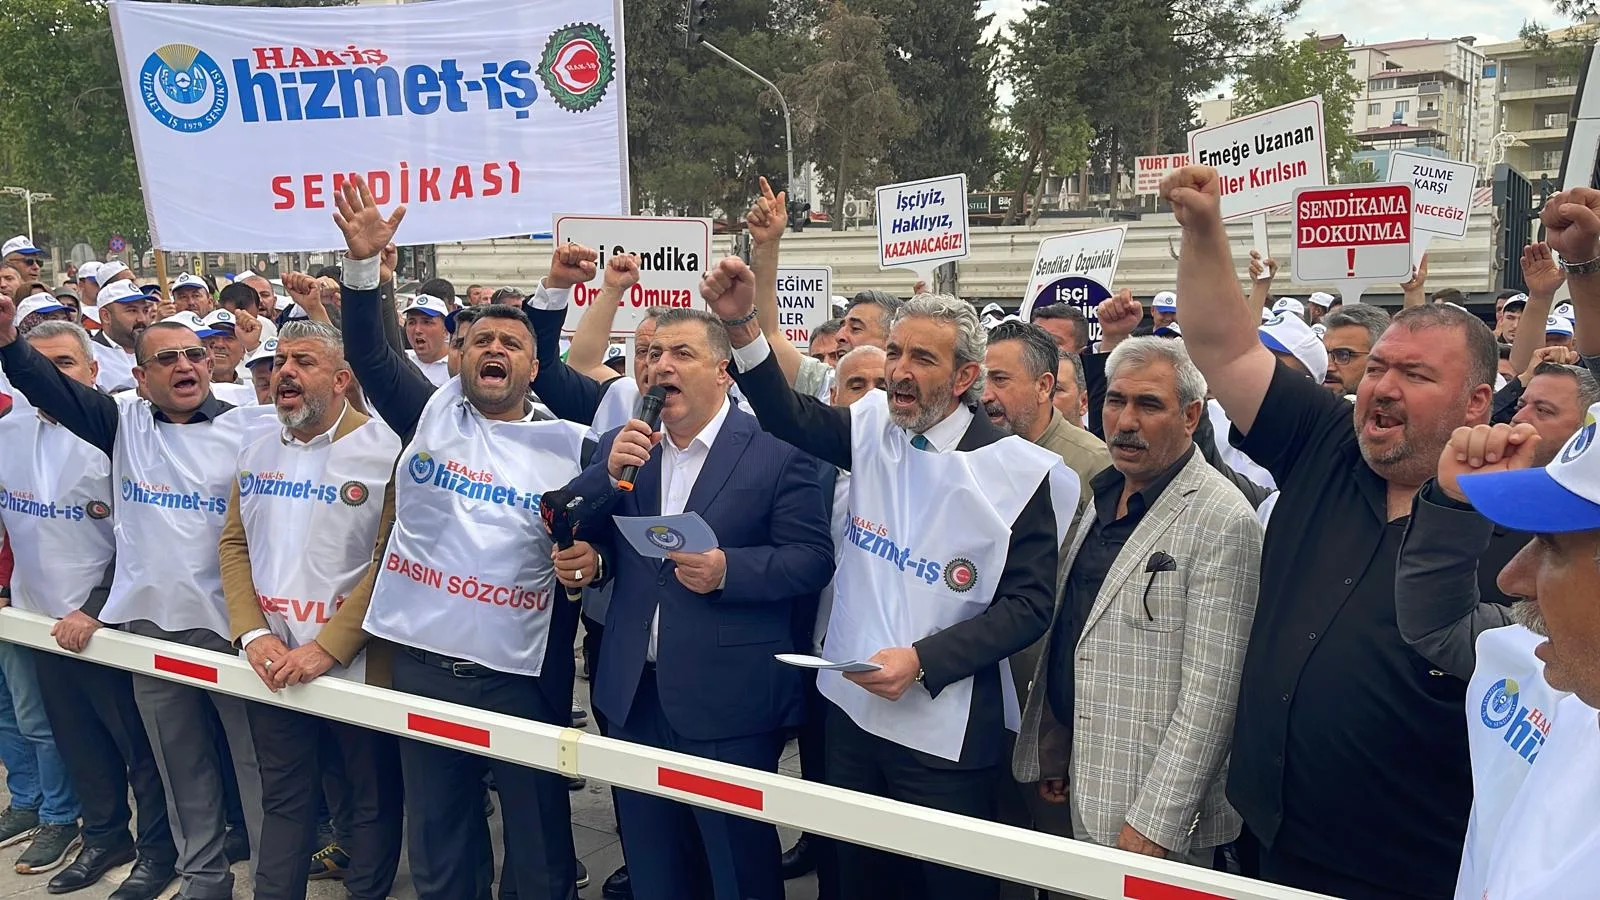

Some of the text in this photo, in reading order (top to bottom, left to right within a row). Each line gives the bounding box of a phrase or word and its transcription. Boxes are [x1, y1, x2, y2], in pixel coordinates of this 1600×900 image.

[232, 58, 539, 122] hizmet-iş
[184, 122, 203, 130] 1979
[1199, 125, 1314, 168] Emeğe Uzanan
[1138, 157, 1169, 170] YURT
[1412, 165, 1454, 181] ZULME
[1219, 160, 1307, 196] ller Kırılsın
[1414, 178, 1448, 195] KARŞI
[896, 188, 945, 211] İşçiyiz,
[1300, 192, 1408, 220] SENDİKAMA
[1415, 203, 1464, 221] NECEĞİZ
[892, 213, 953, 234] Haklıyız,
[1301, 222, 1406, 244] DOKUNMA
[885, 232, 963, 258] KAZANACAĞIZ!
[1036, 247, 1115, 276] Sendikal Özgürlük
[1347, 248, 1356, 277] !
[630, 283, 691, 308] Omuza
[777, 275, 823, 291] EĞİME
[780, 313, 804, 325] LER
[133, 483, 227, 515] hizmet-iş
[253, 476, 338, 504] hizmet-iş
[434, 464, 541, 515] hizmet-iş
[9, 492, 84, 521] hizmet-iş
[386, 553, 549, 611] BASIN SÖZCÜSÜ
